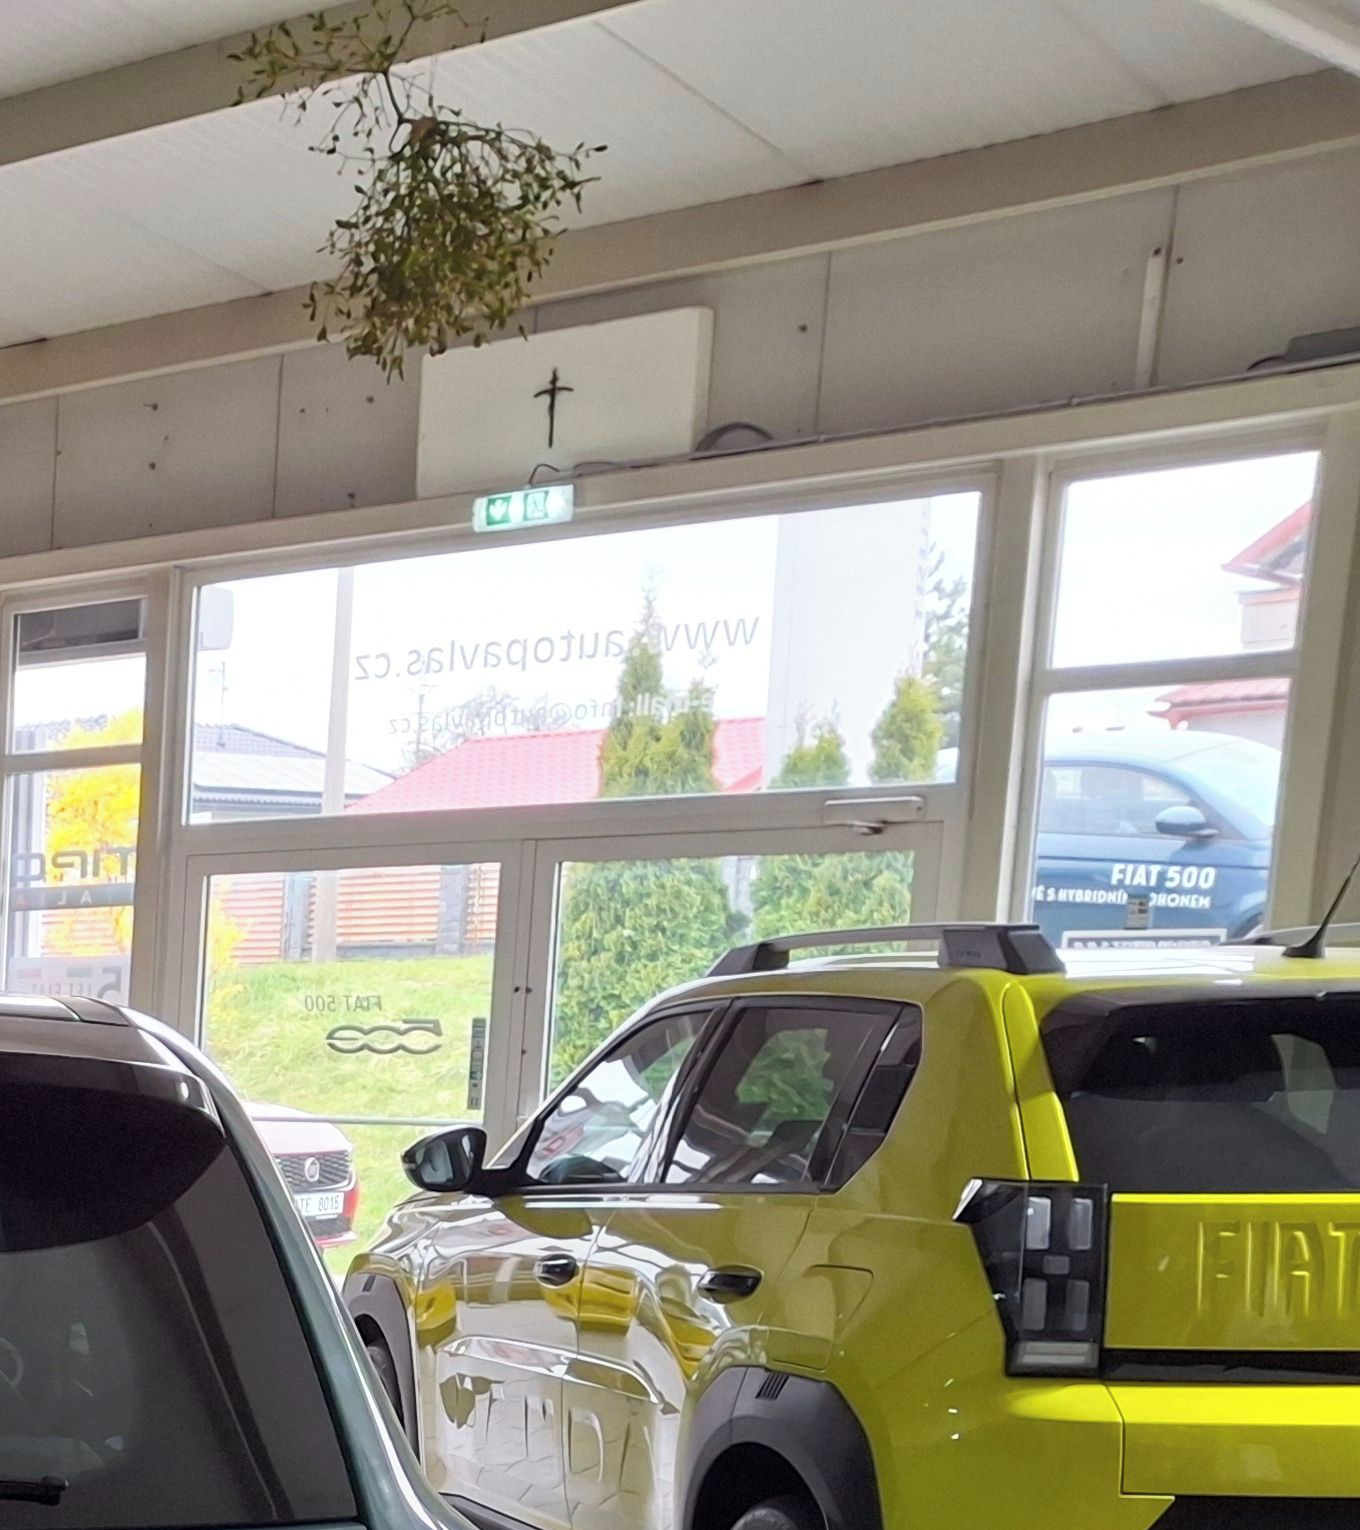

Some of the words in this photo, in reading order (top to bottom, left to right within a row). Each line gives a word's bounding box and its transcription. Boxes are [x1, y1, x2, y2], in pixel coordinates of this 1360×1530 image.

[1110, 863, 1162, 887] FIAT
[1164, 865, 1217, 889] 500
[1197, 1220, 1360, 1319] FIAT
